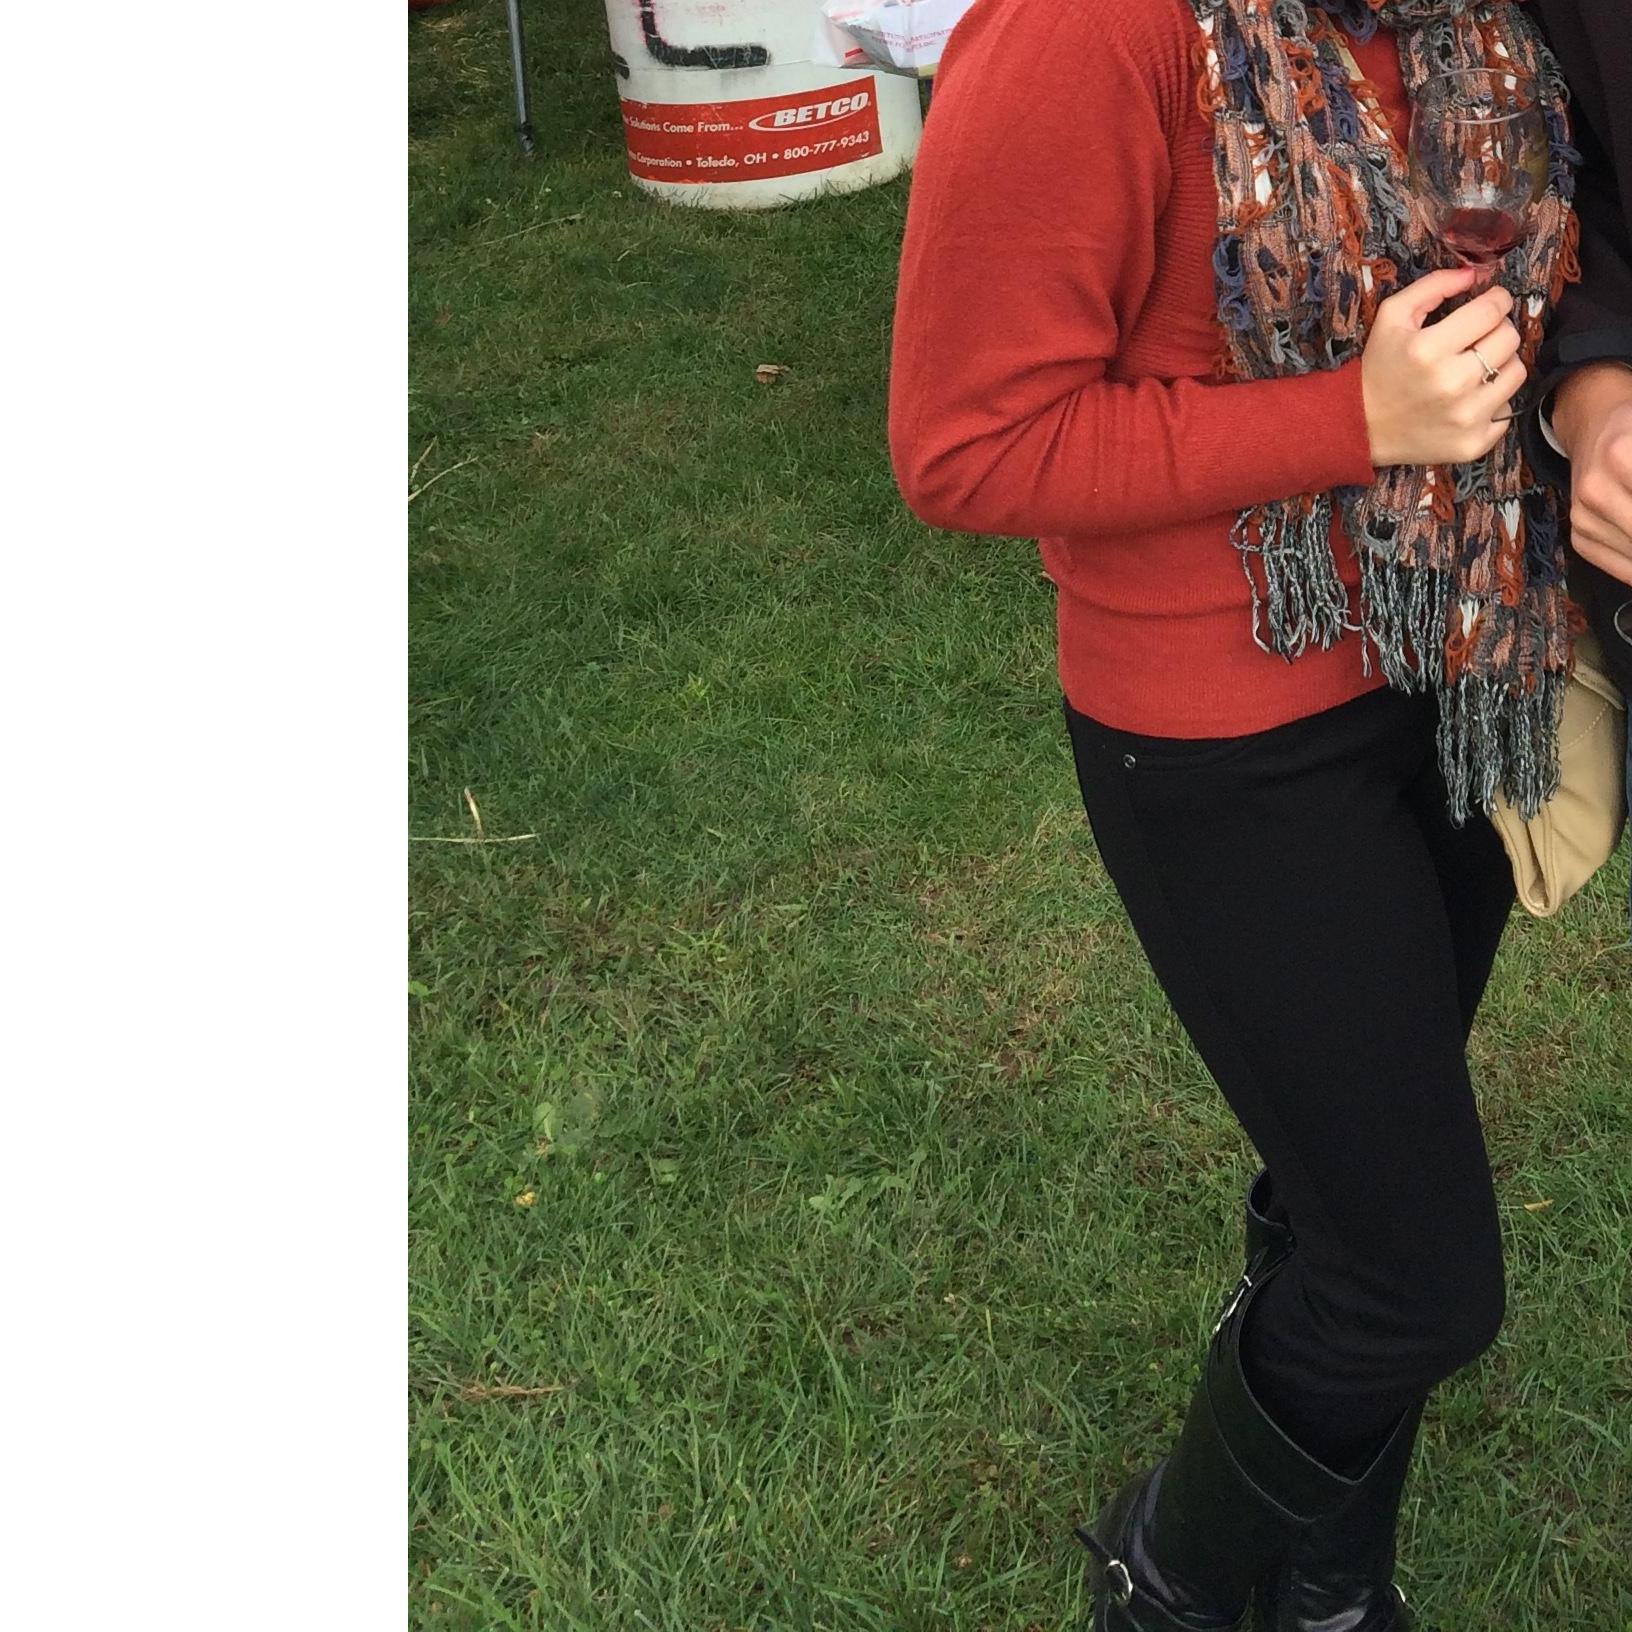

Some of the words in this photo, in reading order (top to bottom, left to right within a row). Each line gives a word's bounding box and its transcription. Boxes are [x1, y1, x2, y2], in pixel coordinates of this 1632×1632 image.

[663, 121, 694, 133] Come
[697, 122, 744, 133] From...
[773, 91, 870, 127] BETCO
[637, 152, 682, 168] Corporation
[696, 154, 740, 169] Toledo,
[744, 153, 767, 165] OH
[783, 130, 870, 160] 800-777-9343
